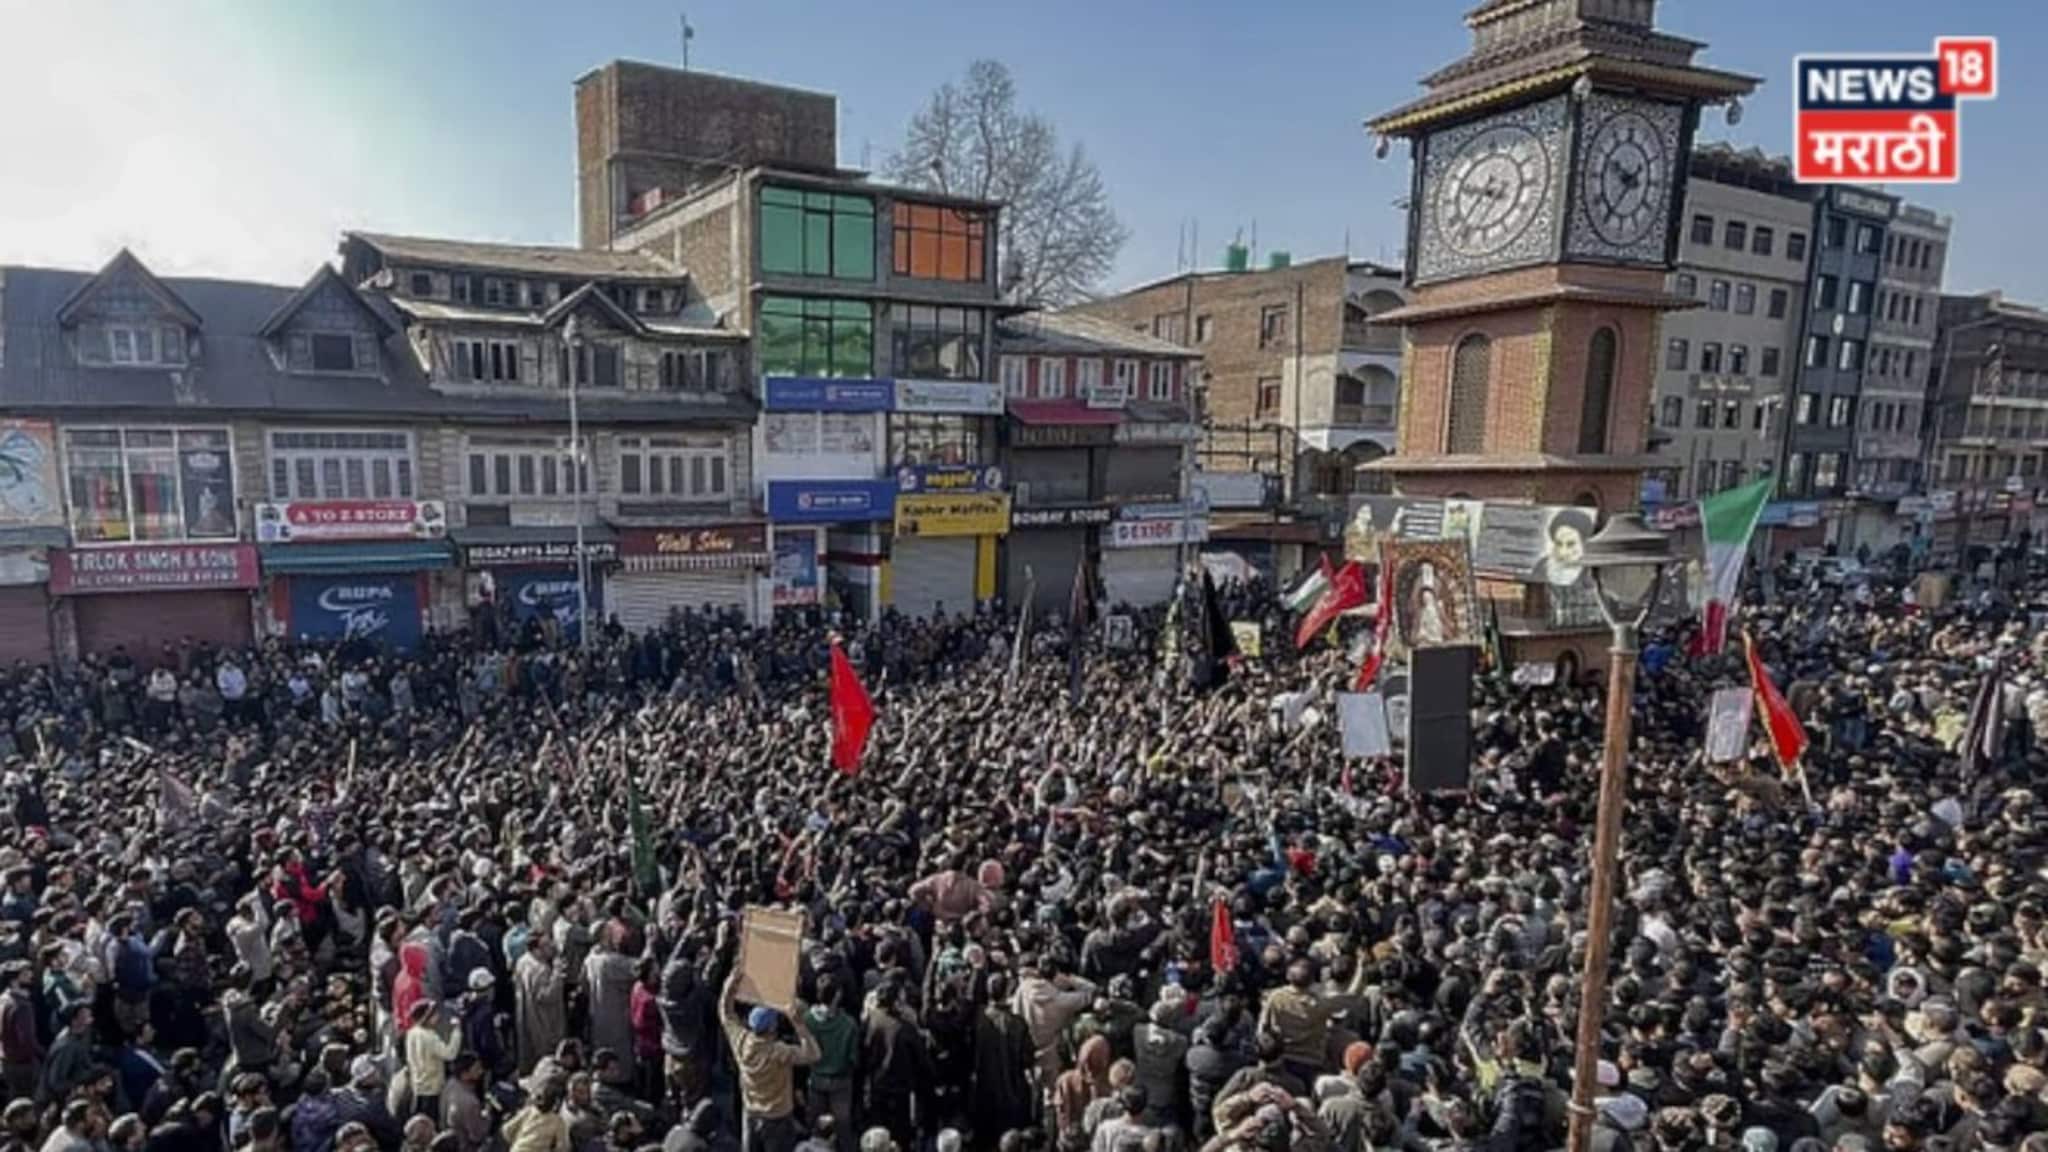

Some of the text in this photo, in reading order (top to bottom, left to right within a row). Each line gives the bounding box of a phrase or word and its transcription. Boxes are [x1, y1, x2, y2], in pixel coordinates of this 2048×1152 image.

[295, 509, 410, 522] A TO Z STORE
[338, 586, 394, 600] RUPA
